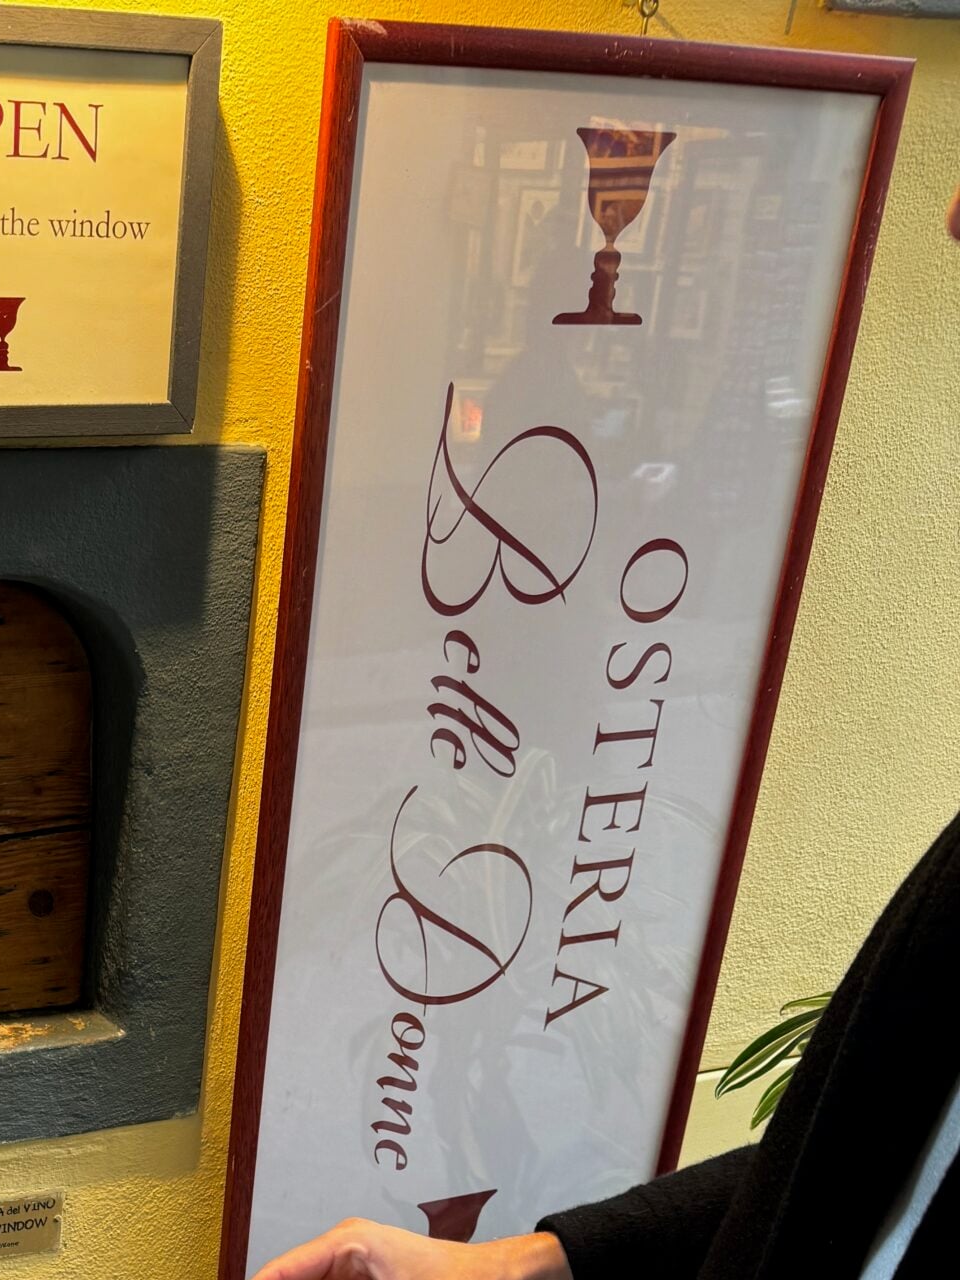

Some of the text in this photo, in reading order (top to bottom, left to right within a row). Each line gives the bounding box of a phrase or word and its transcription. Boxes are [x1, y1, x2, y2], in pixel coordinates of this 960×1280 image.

[0, 207, 40, 237] the
[48, 209, 151, 240] window
[370, 381, 598, 1171] Belle Donne
[543, 537, 689, 1032] OSTERIA
[6, 1205, 20, 1216] del
[23, 1198, 56, 1213] VINO
